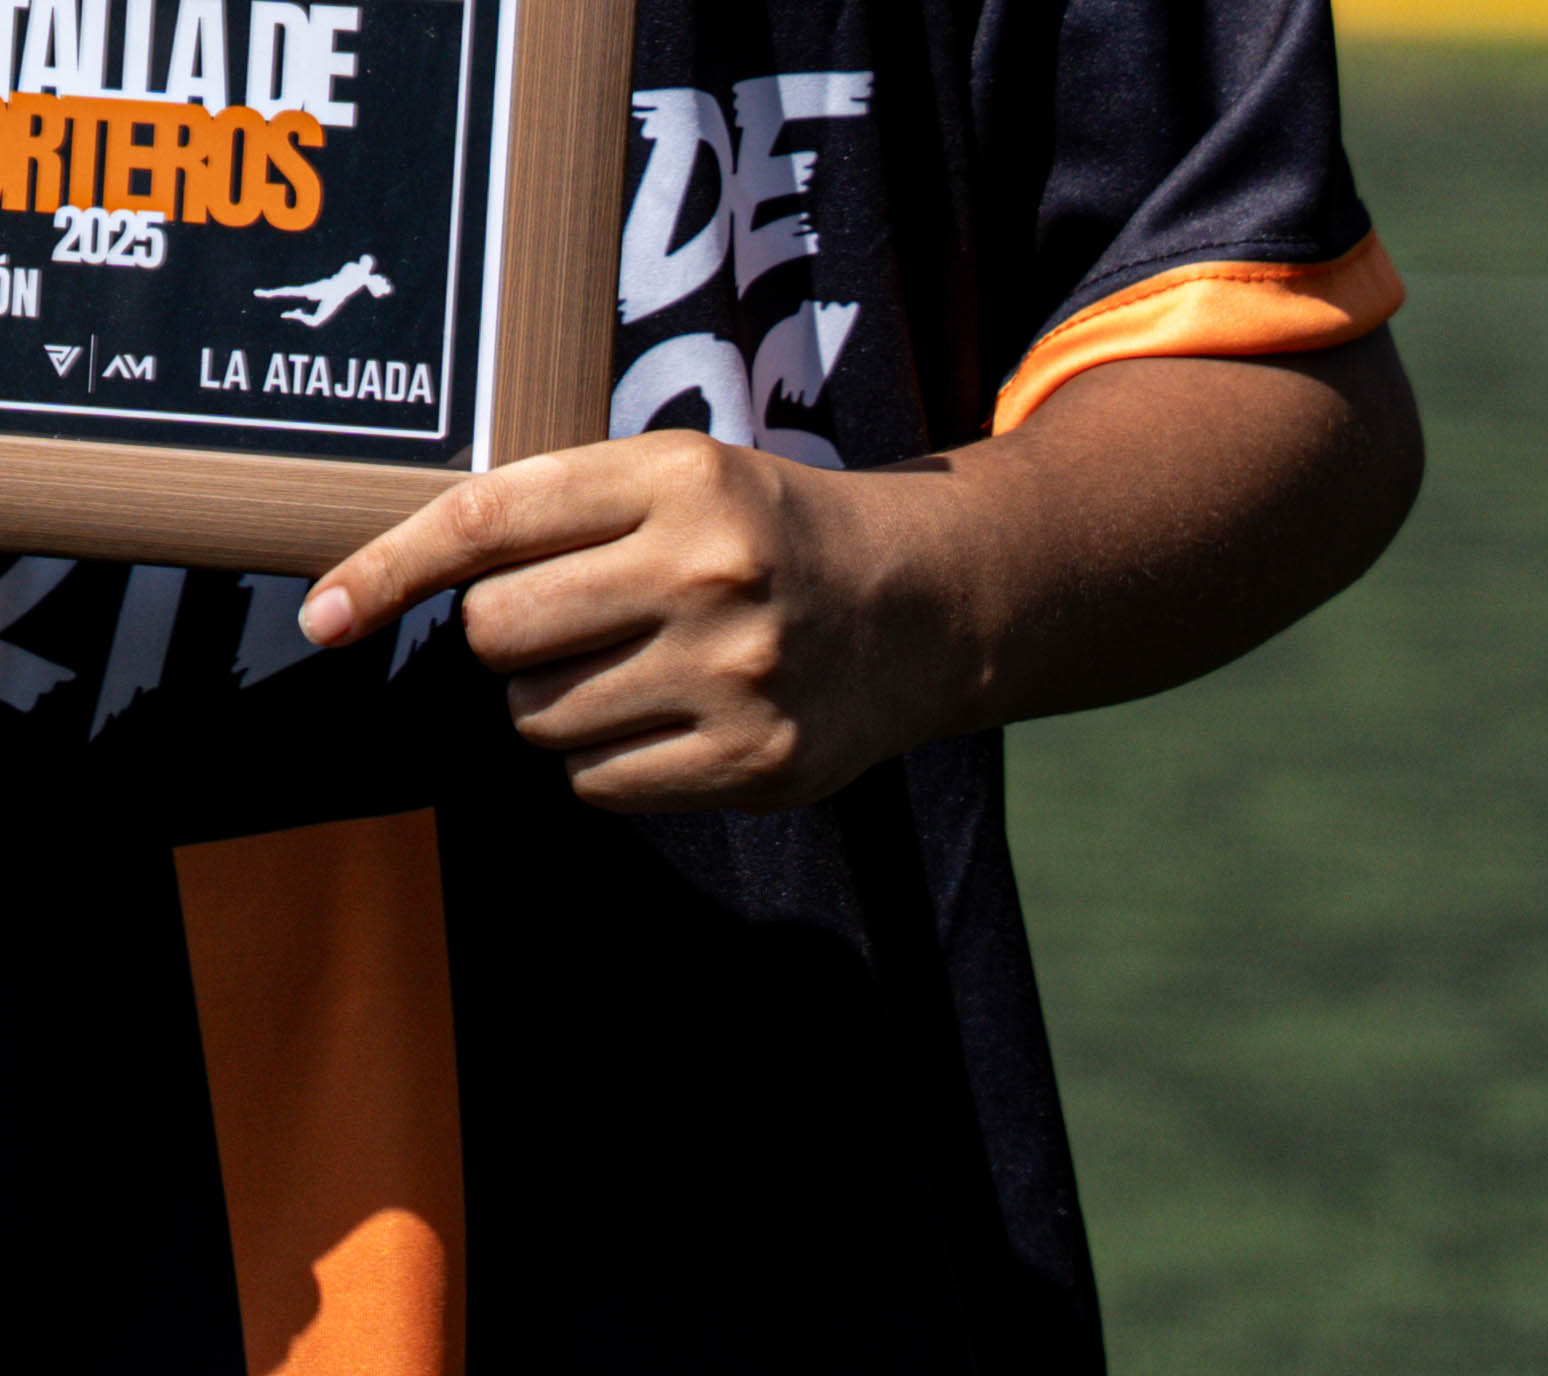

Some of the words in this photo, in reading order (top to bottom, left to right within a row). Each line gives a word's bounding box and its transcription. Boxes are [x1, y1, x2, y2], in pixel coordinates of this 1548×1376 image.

[245, 0, 362, 128] DE
[51, 205, 166, 270] 2025
[618, 71, 875, 325] DE
[199, 348, 251, 392] LA
[262, 353, 435, 405] ATAJADA
